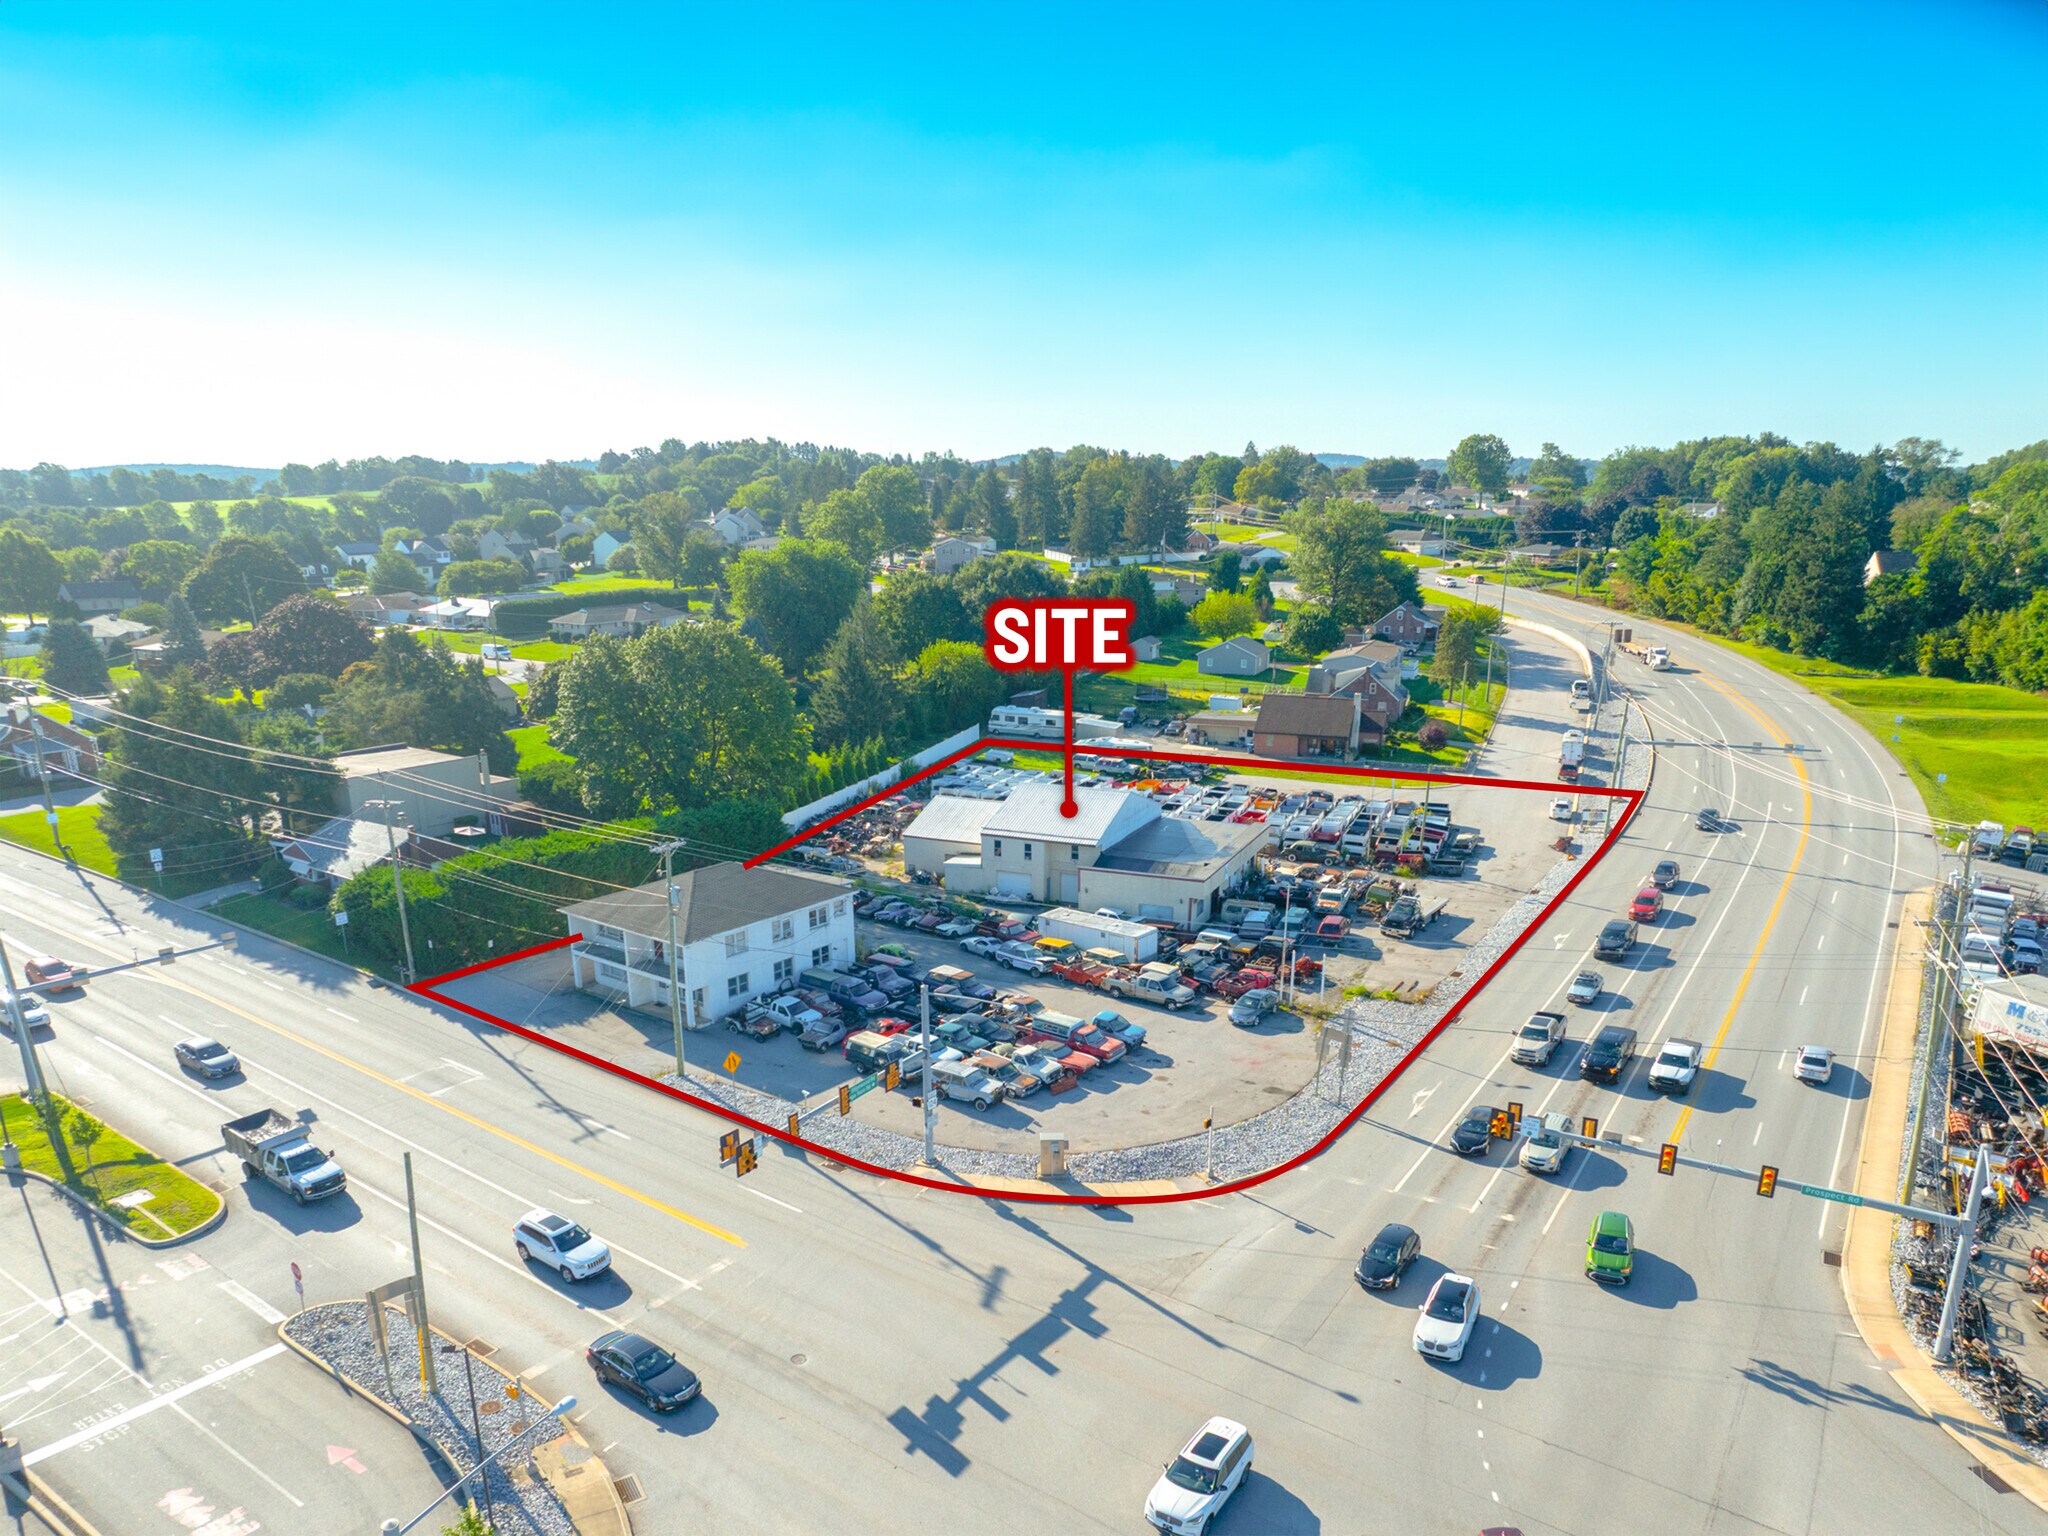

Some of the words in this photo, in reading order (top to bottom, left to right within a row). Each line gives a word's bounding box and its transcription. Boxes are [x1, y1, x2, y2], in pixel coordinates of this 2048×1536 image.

[2006, 1002, 2026, 1019] M
[2016, 1022, 2048, 1040] 755-
[1805, 1187, 1845, 1200] Prospect
[1847, 1195, 1860, 1204] Rd
